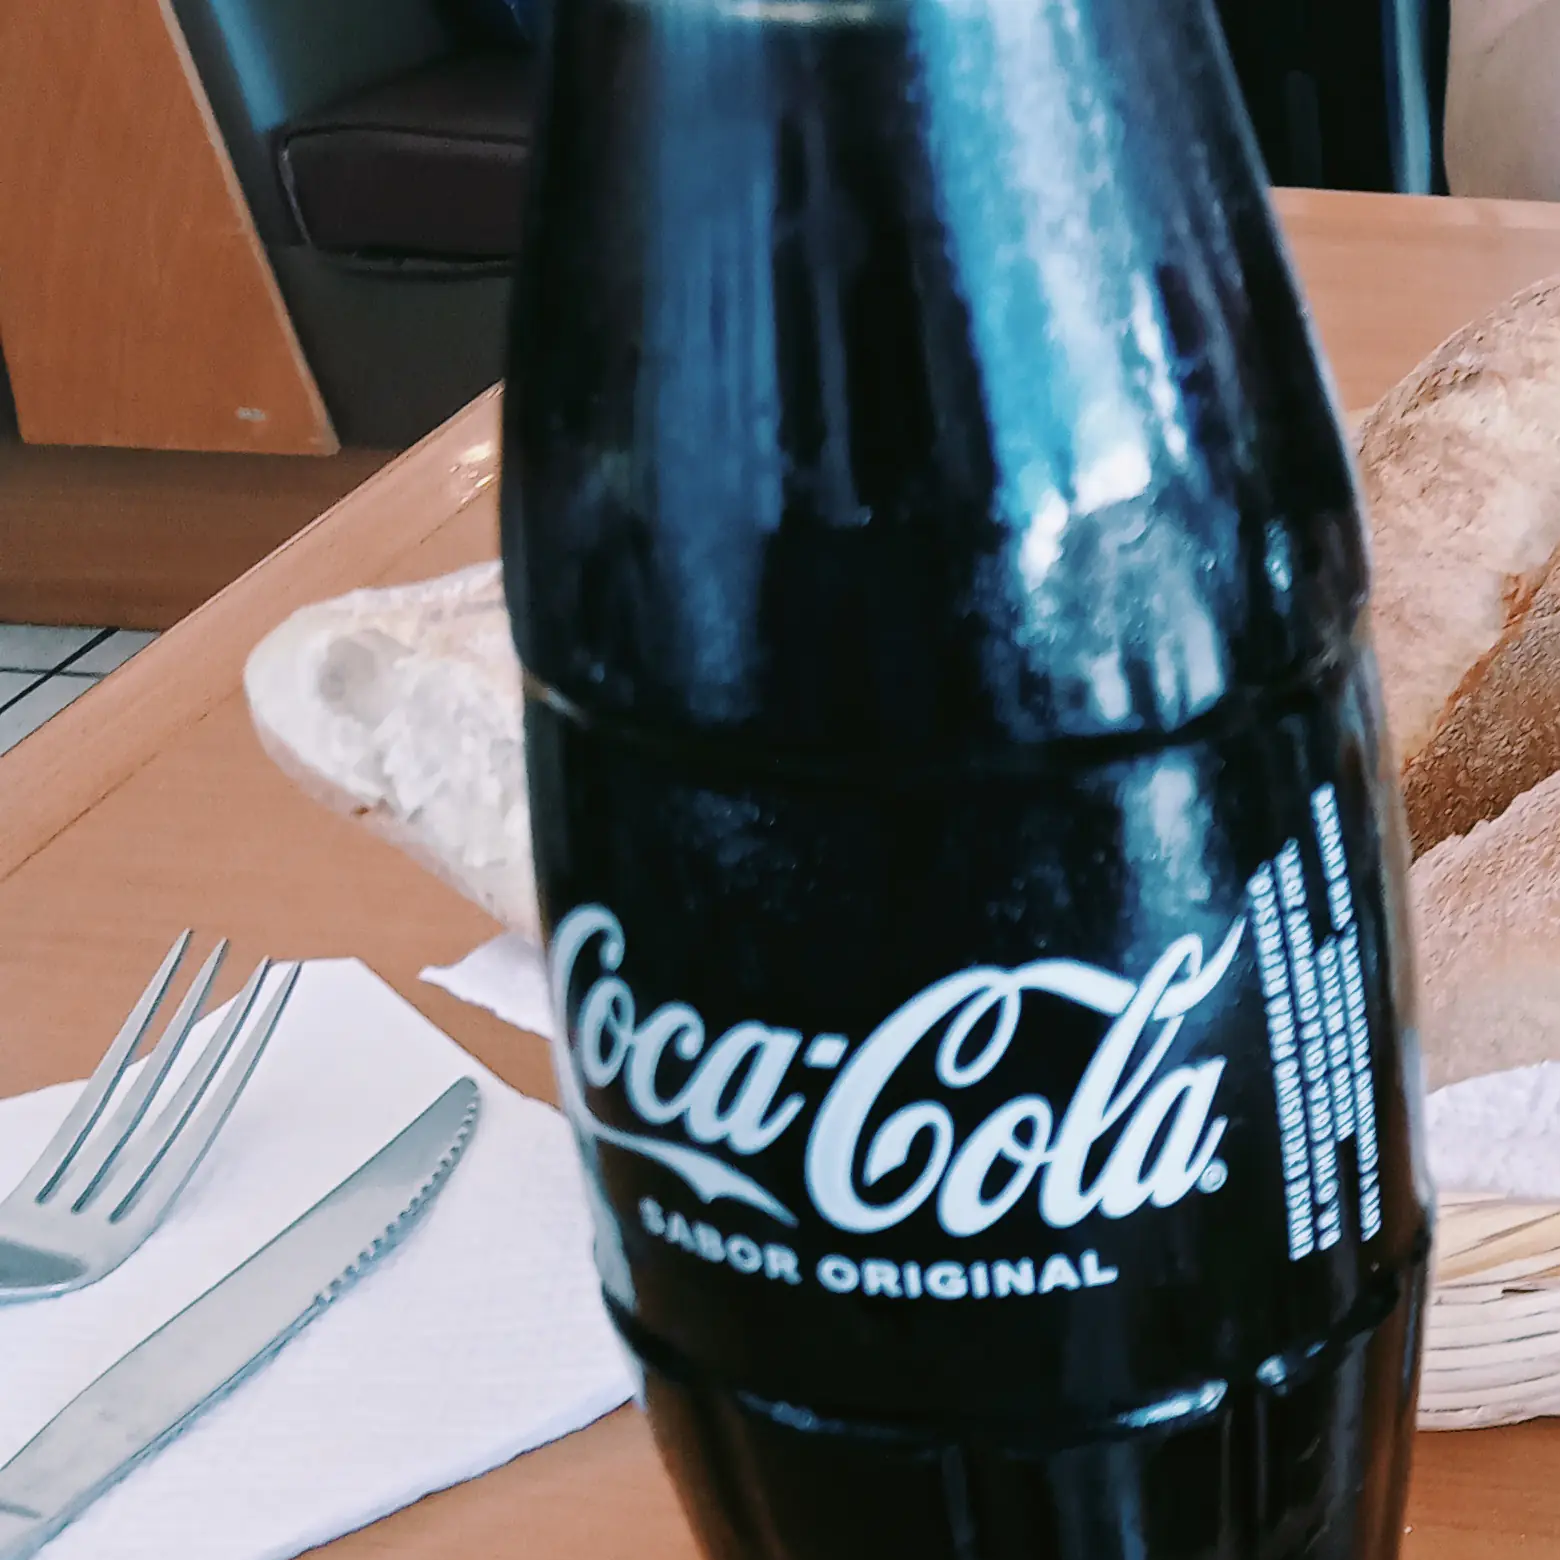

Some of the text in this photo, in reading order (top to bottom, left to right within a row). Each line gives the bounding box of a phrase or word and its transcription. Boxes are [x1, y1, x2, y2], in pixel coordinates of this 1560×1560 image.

[548, 904, 1247, 1237] Coca-Cola
[637, 1197, 1119, 1300] SABOR ORIGINAL
